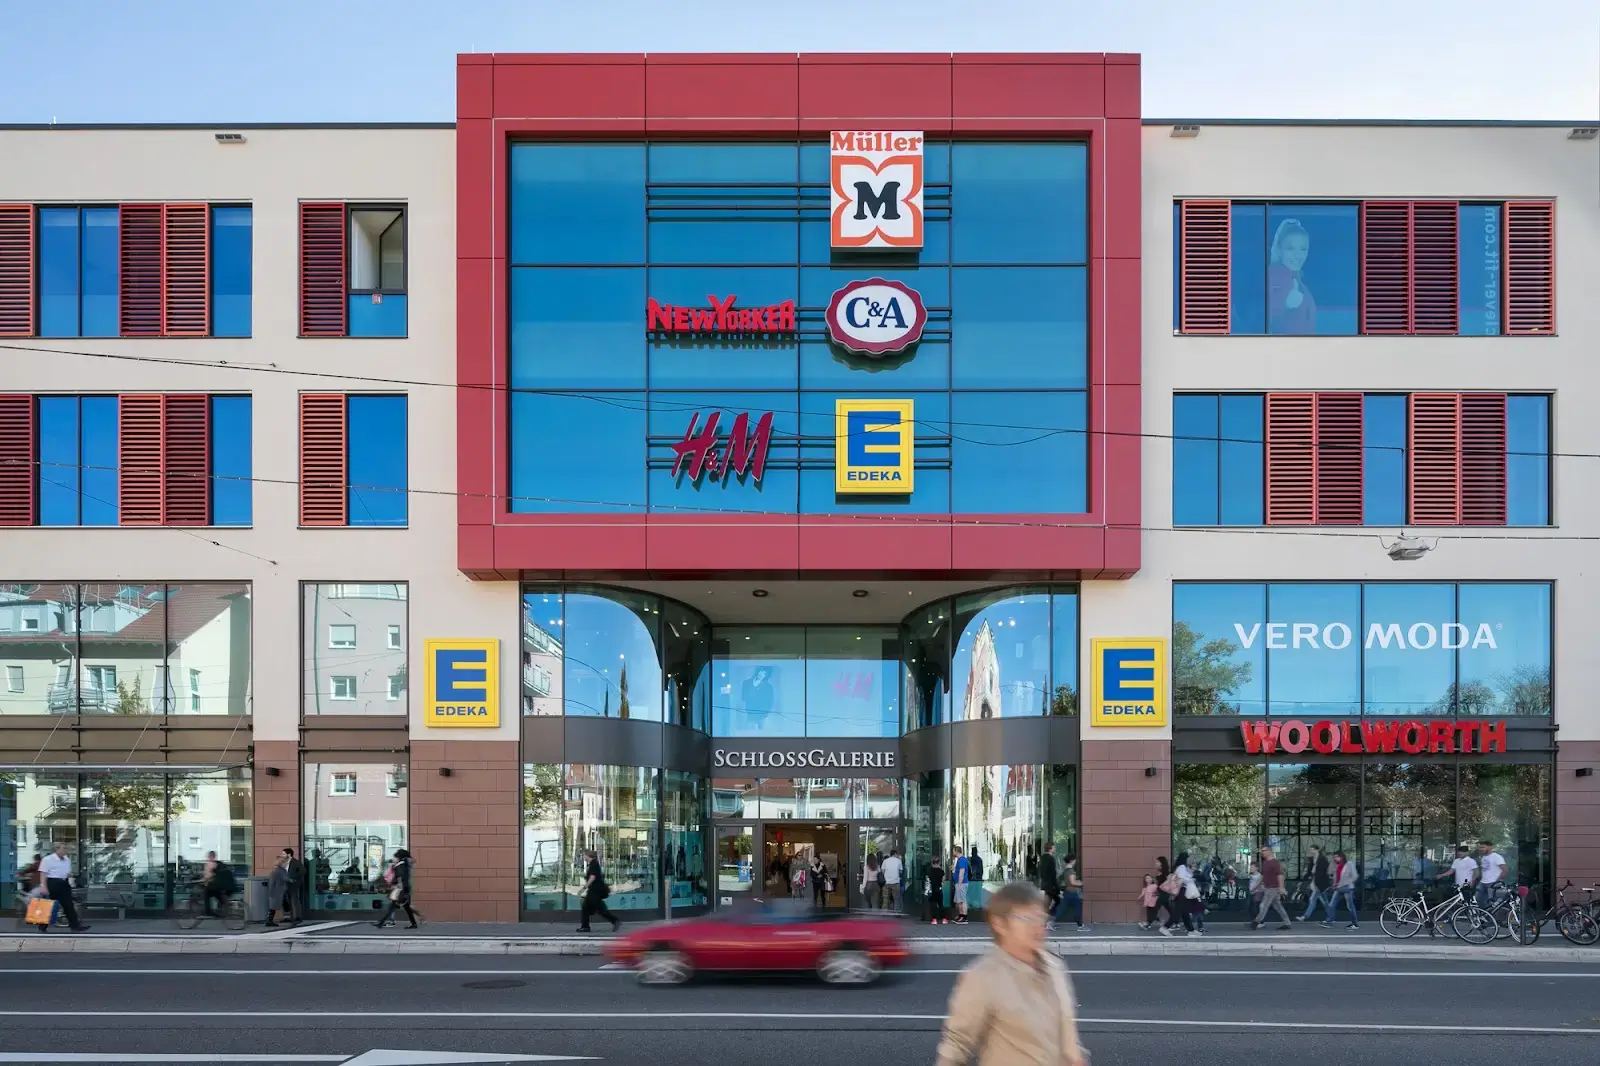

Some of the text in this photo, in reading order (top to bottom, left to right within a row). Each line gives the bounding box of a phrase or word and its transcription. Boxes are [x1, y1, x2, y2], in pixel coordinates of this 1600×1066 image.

[831, 131, 923, 152] Müller
[853, 181, 902, 220] M
[846, 297, 909, 329] C&A
[671, 411, 775, 482] H&M
[847, 471, 902, 481] EDEKA
[1234, 622, 1352, 650] VERO
[435, 706, 488, 716] EDEKA
[1103, 705, 1155, 716] EDEKA
[1240, 720, 1507, 754] WOOLWORTH
